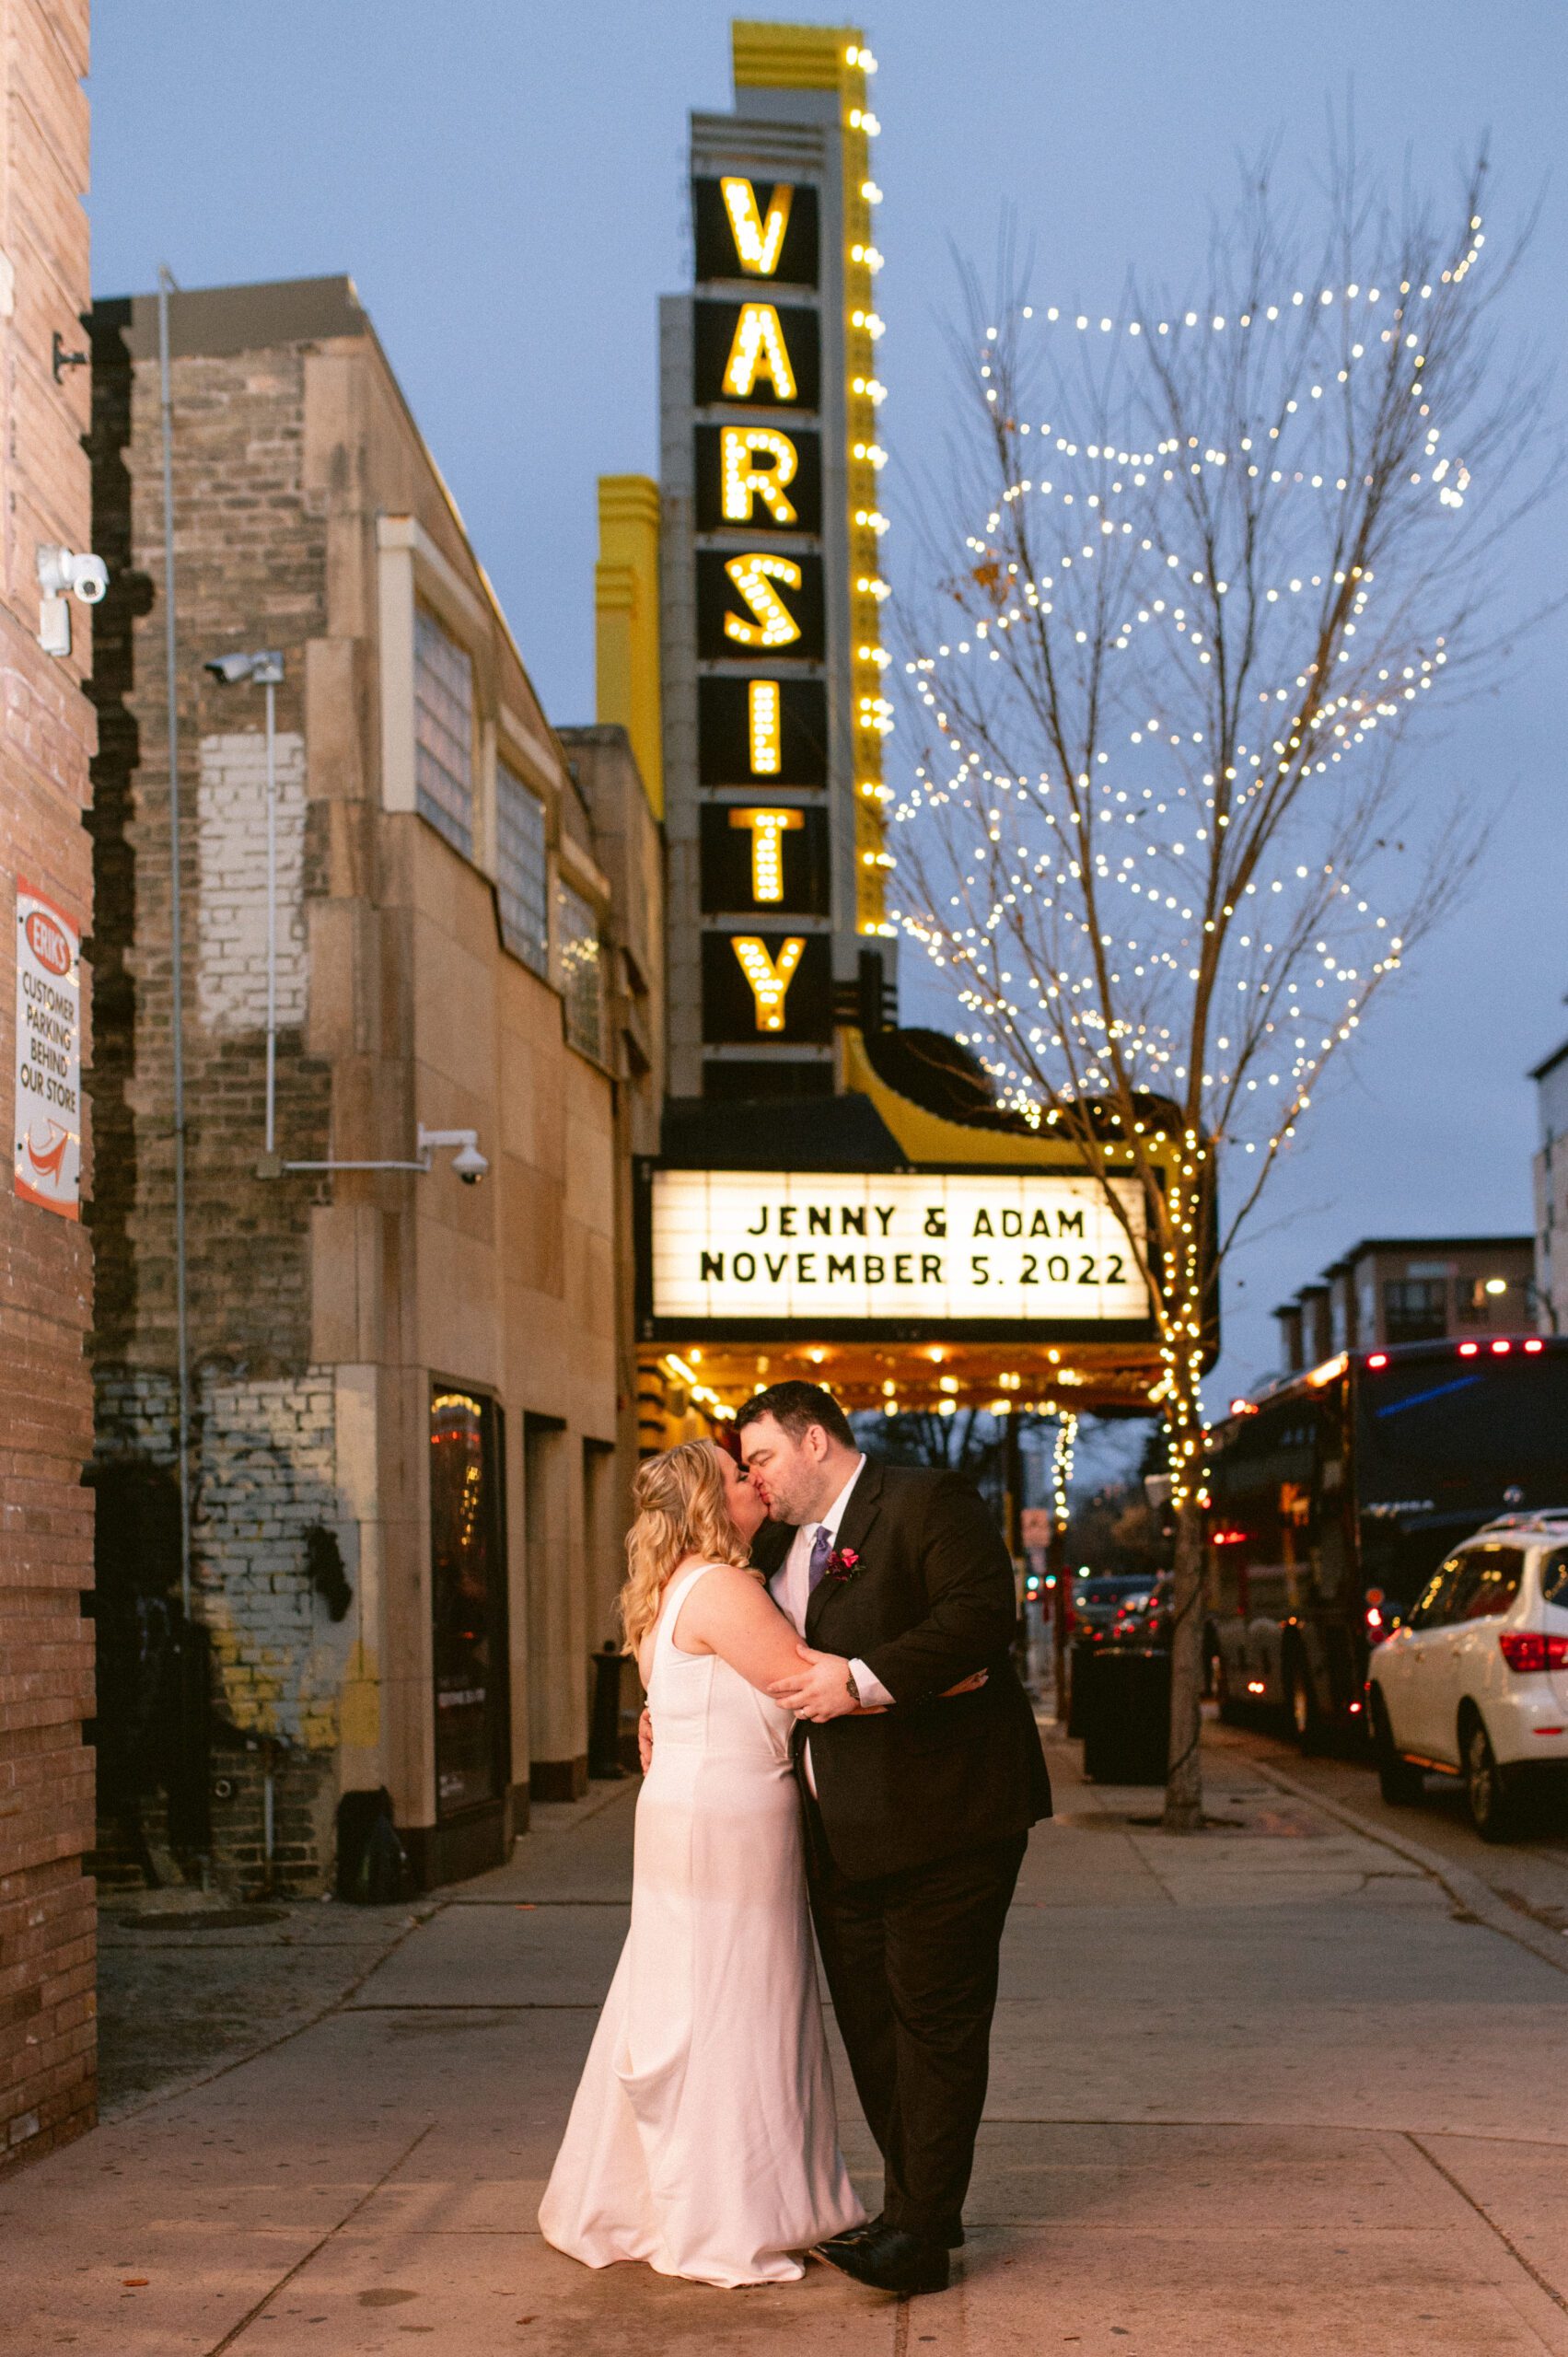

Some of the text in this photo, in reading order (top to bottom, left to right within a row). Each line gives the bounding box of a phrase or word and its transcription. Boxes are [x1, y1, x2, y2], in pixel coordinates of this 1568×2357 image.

[719, 176, 807, 1032] VARSITY
[22, 971, 75, 1024] CUSTOMER
[27, 1004, 71, 1051] PARKING
[30, 1038, 67, 1078] BEHIND
[20, 1063, 76, 1113] OUR STORE
[748, 1206, 1084, 1237] JENNY & ADAM
[700, 1251, 942, 1283] NOVEMBER
